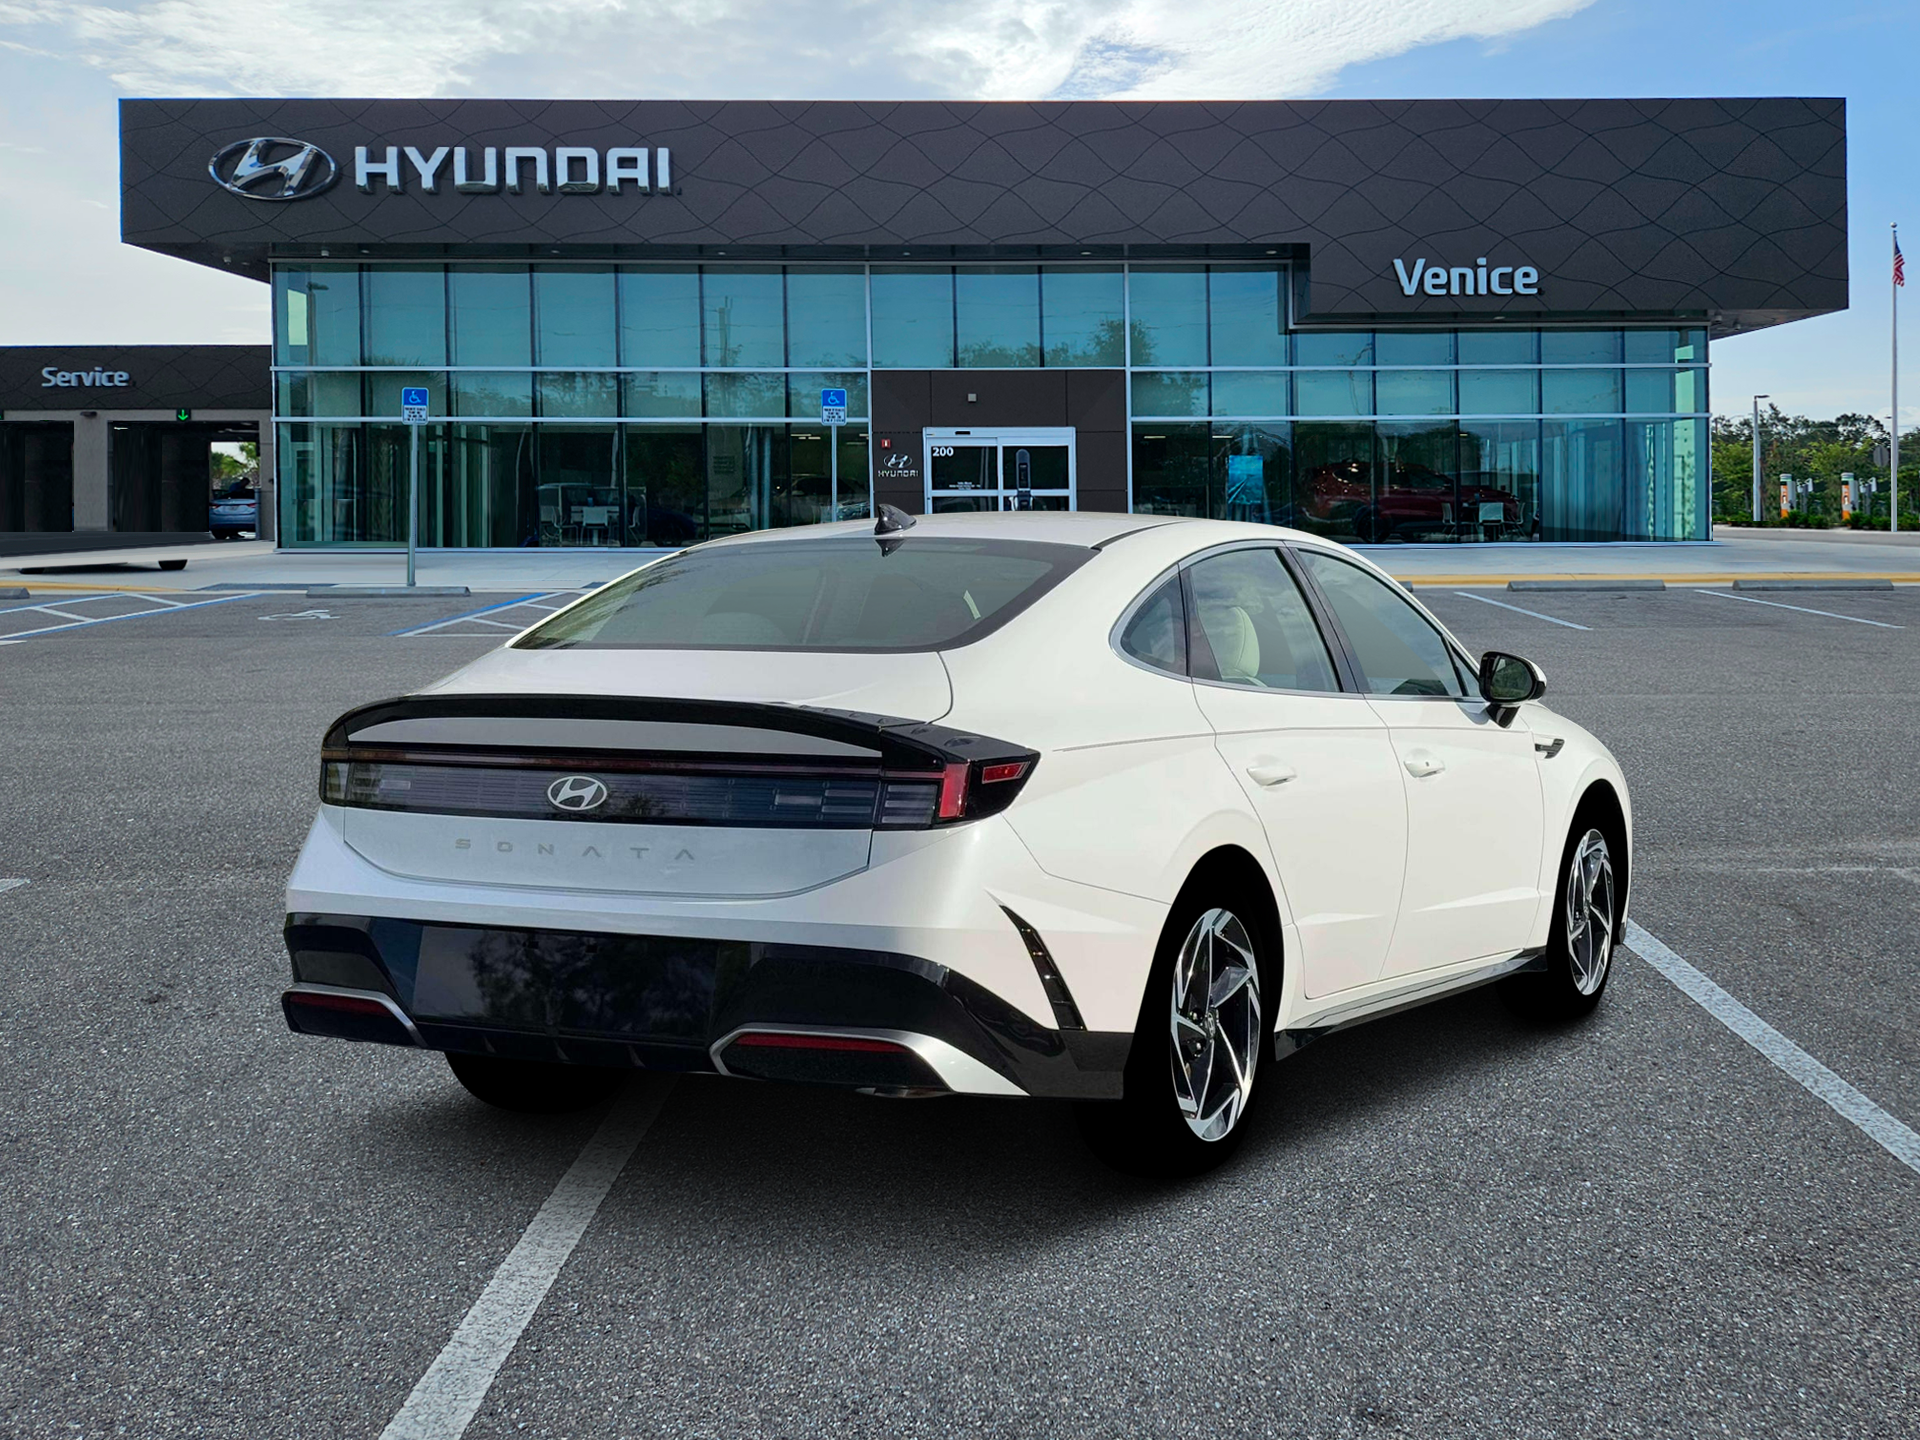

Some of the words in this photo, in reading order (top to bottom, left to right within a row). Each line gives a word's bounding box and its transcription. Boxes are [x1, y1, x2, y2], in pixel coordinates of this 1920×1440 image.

[354, 146, 671, 194] HYUNDAI
[1393, 257, 1538, 295] Venice
[41, 366, 130, 388] Service
[932, 446, 954, 457] 200
[455, 838, 695, 861] SONATA
